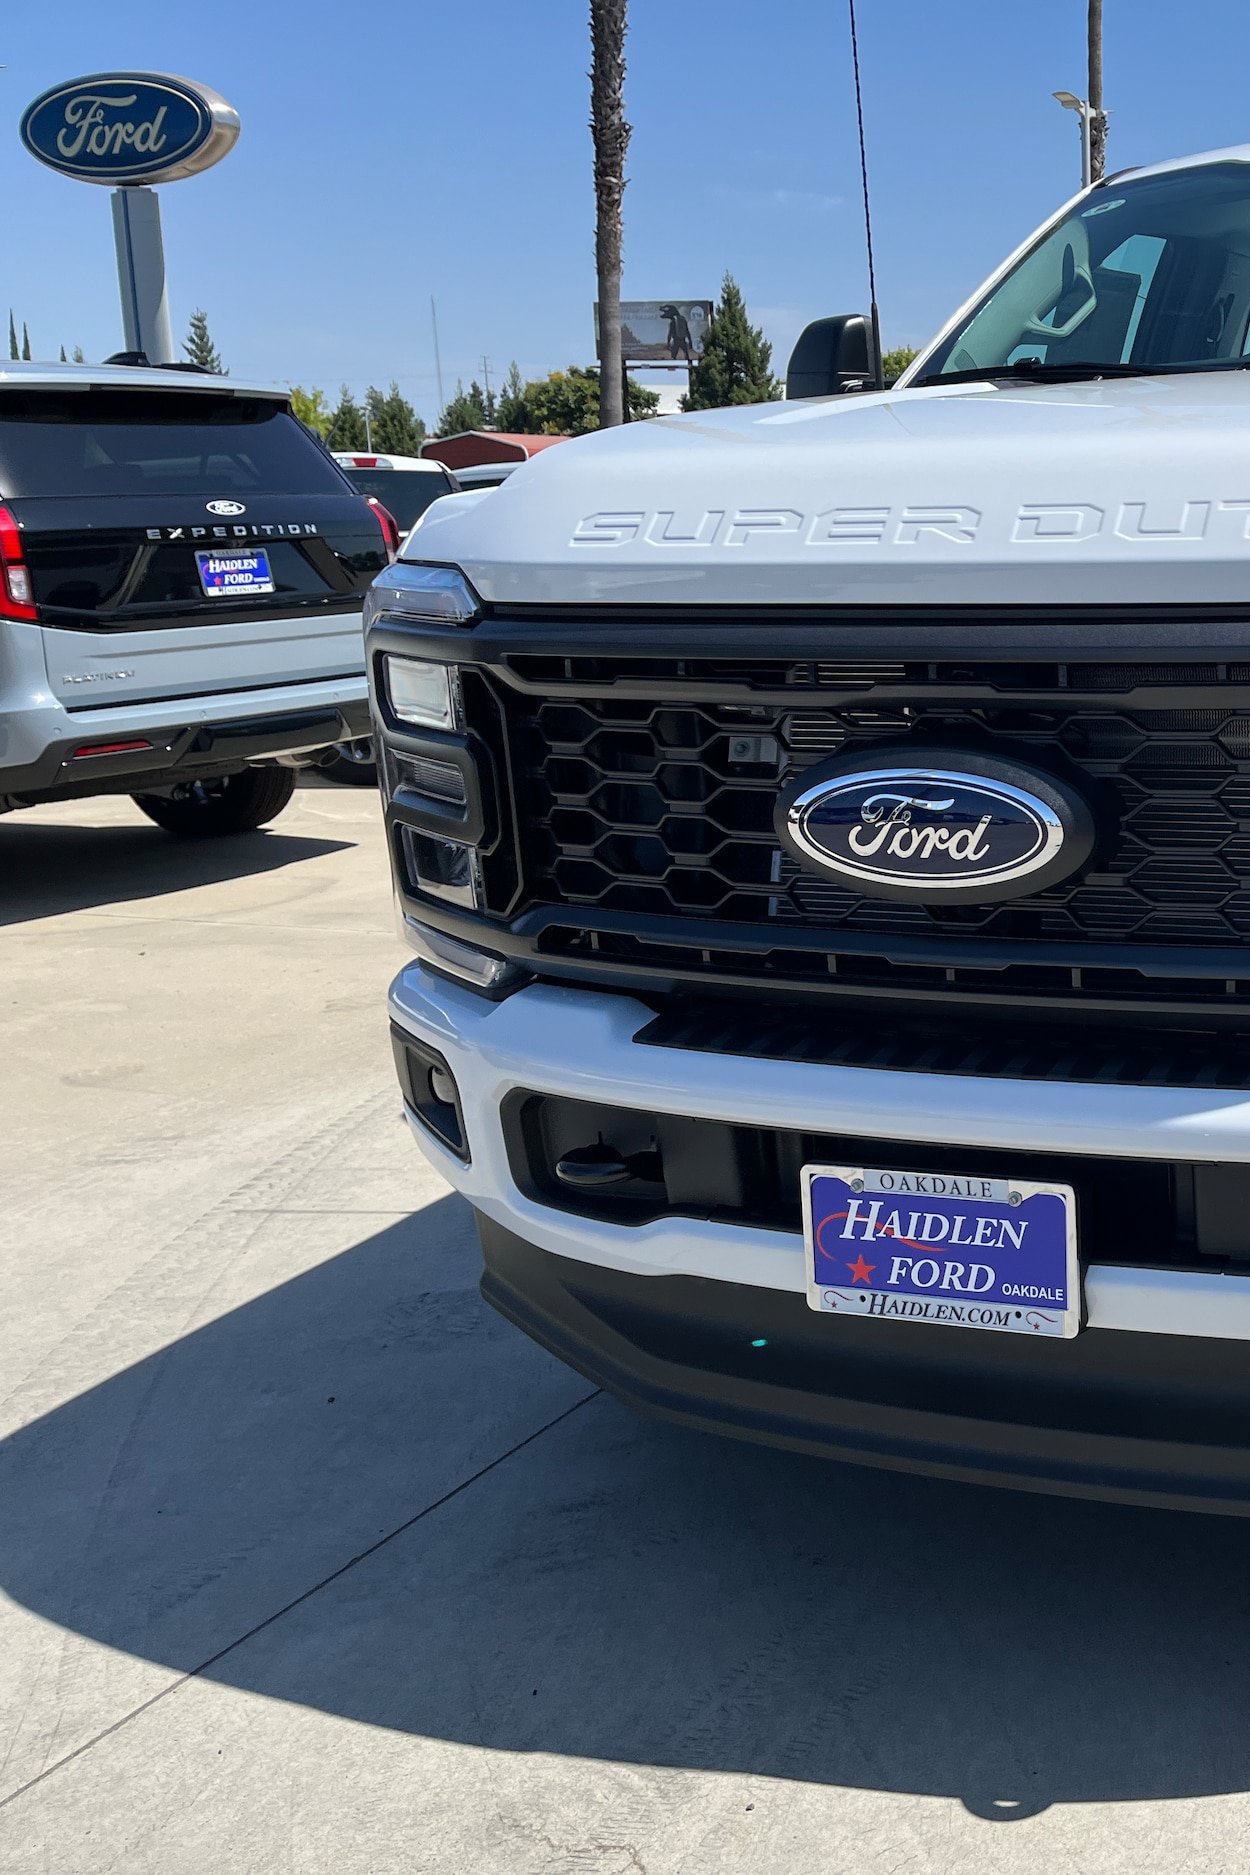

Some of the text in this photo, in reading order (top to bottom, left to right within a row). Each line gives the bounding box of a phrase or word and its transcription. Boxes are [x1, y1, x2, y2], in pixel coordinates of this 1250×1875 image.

[56, 94, 168, 157] Ford
[146, 523, 318, 540] EXPEDITION
[568, 506, 982, 547] SUPER
[208, 558, 258, 573] HAIDLEN
[223, 572, 253, 585] FORD
[847, 793, 993, 861] Ford
[880, 1173, 993, 1198] OAKDALE
[839, 1198, 1028, 1250] HAIDLEN
[886, 1256, 996, 1293] FORD
[1001, 1283, 1064, 1301] OAKDALE
[867, 1292, 1012, 1327] HAIDLEN.COM
